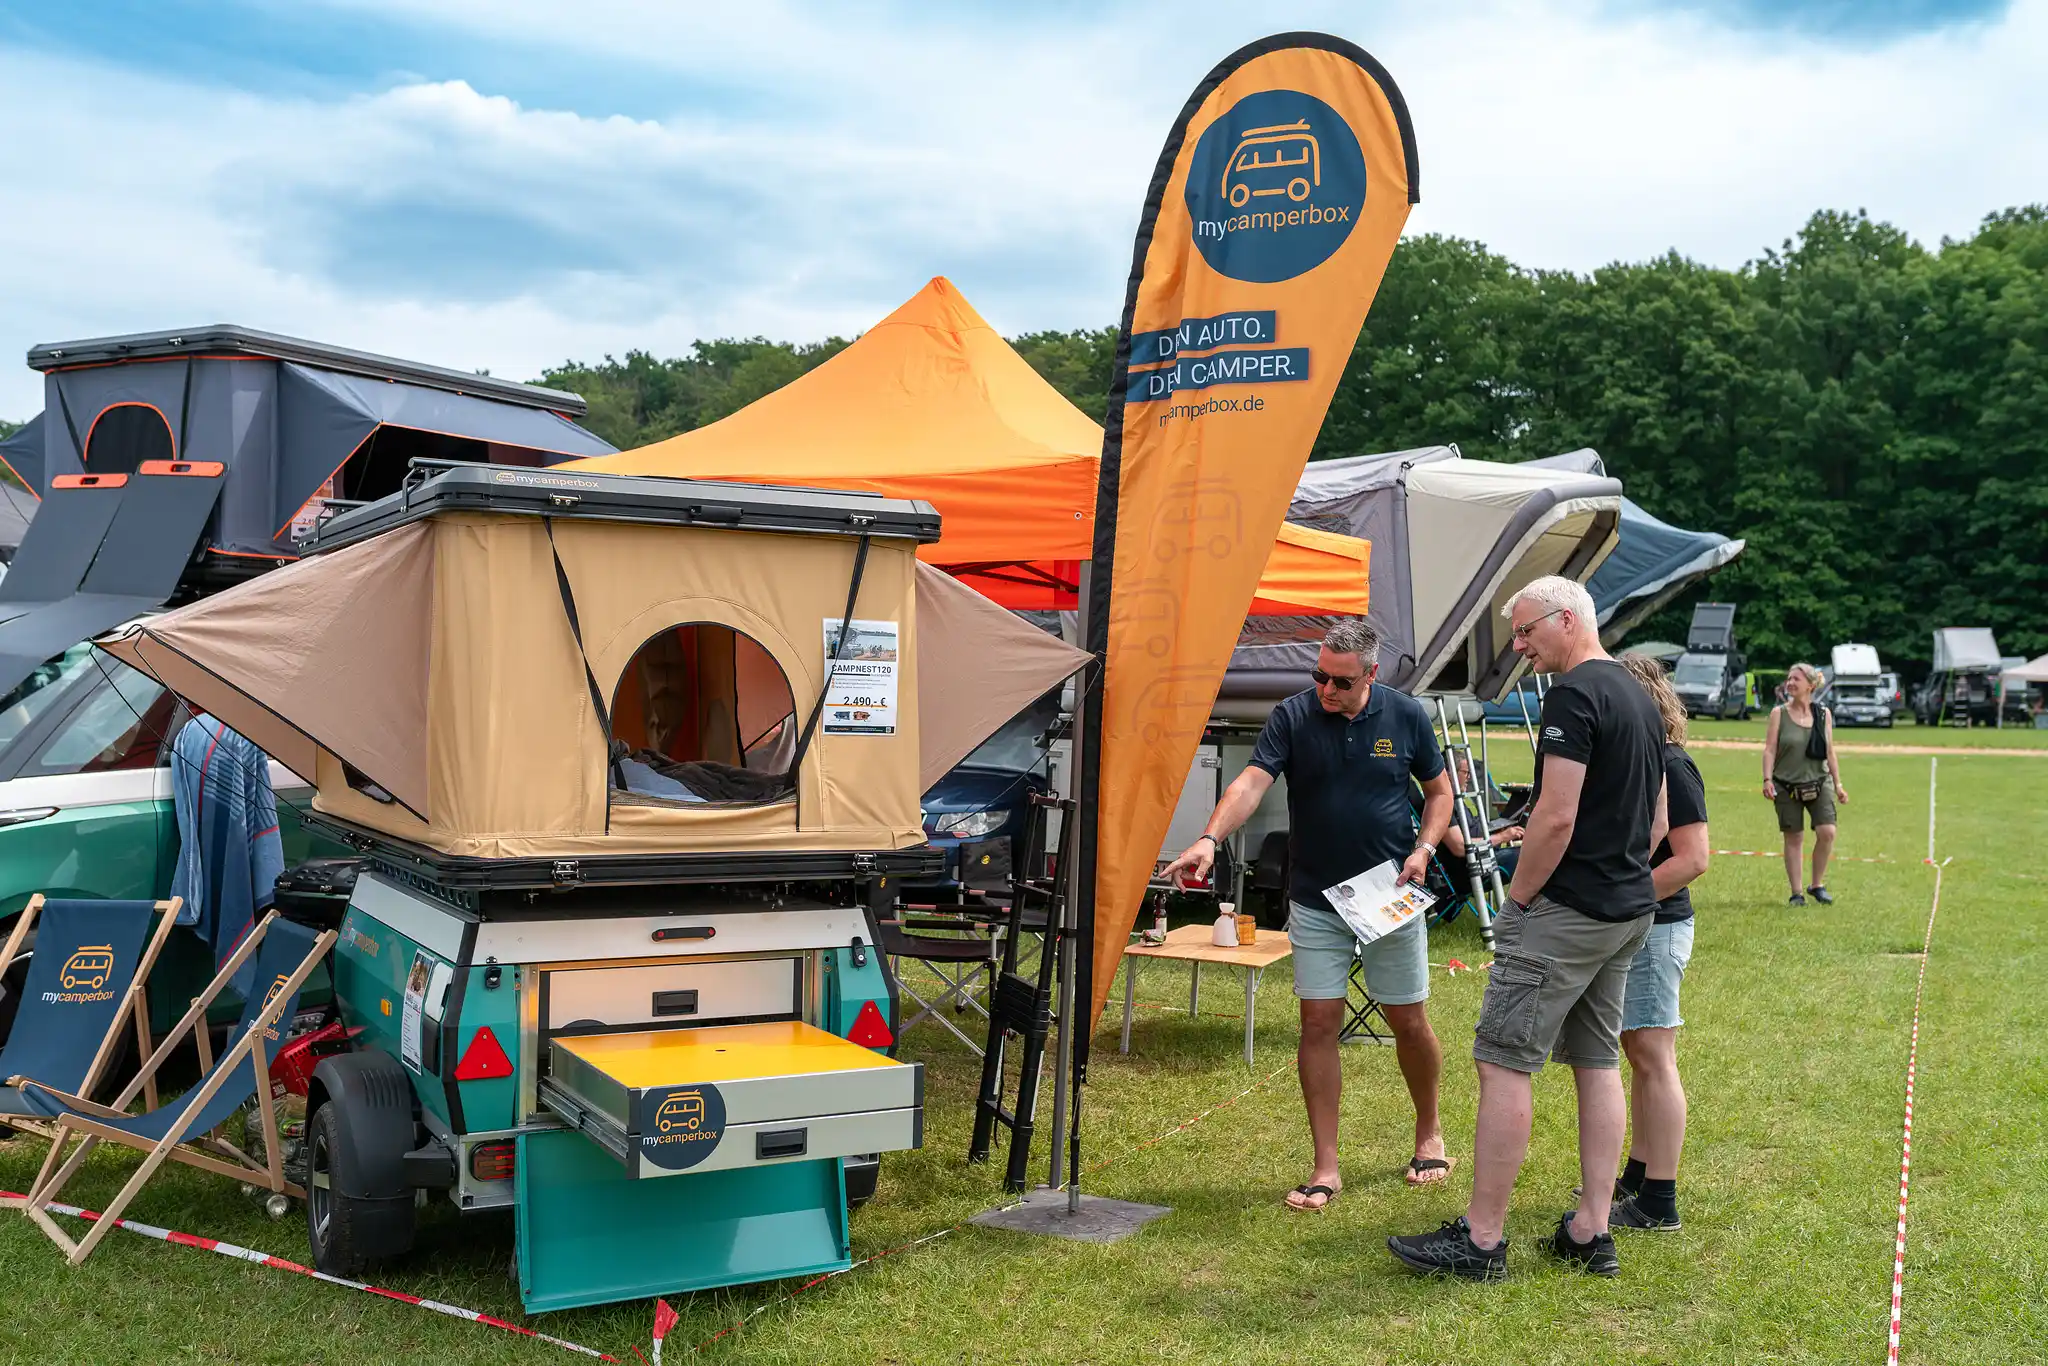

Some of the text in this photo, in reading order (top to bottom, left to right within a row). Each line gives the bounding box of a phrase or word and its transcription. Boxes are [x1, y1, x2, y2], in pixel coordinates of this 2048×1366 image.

[1198, 203, 1350, 242] mycamperbox
[1197, 317, 1267, 346] AUTO.
[1190, 355, 1296, 384] CAMPER.
[516, 474, 600, 489] mycamperbox
[832, 664, 892, 674] CAMPNEST120
[41, 989, 116, 1005] mycamperbox
[642, 1129, 717, 1148] mycamperbox
